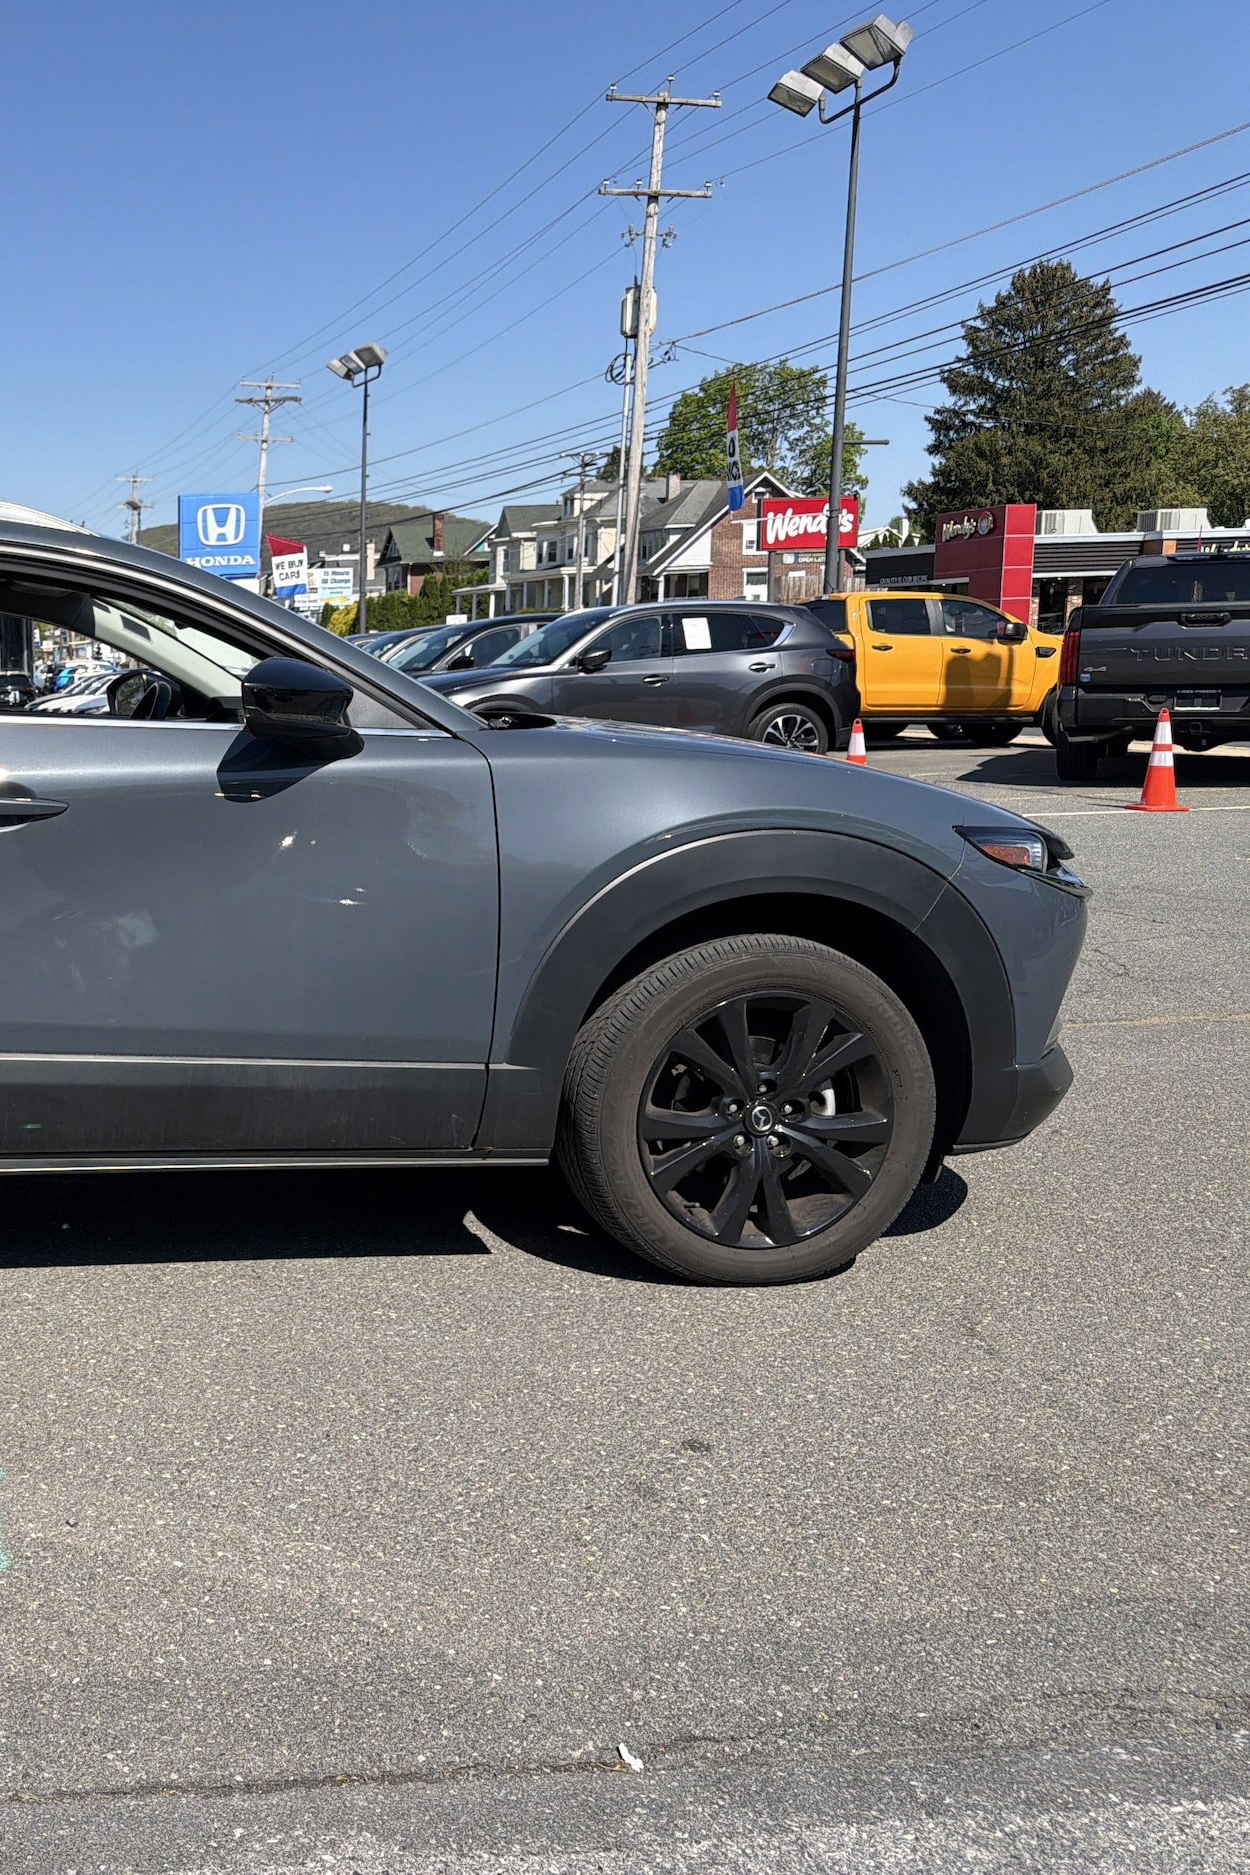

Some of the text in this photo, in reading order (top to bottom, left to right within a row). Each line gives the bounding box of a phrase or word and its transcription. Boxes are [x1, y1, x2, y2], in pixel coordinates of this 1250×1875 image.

[766, 503, 855, 545] Wend's
[941, 515, 977, 542] Wendy's
[185, 555, 256, 567] HONDA
[275, 559, 305, 570] WE BUY
[278, 569, 301, 581] CARS
